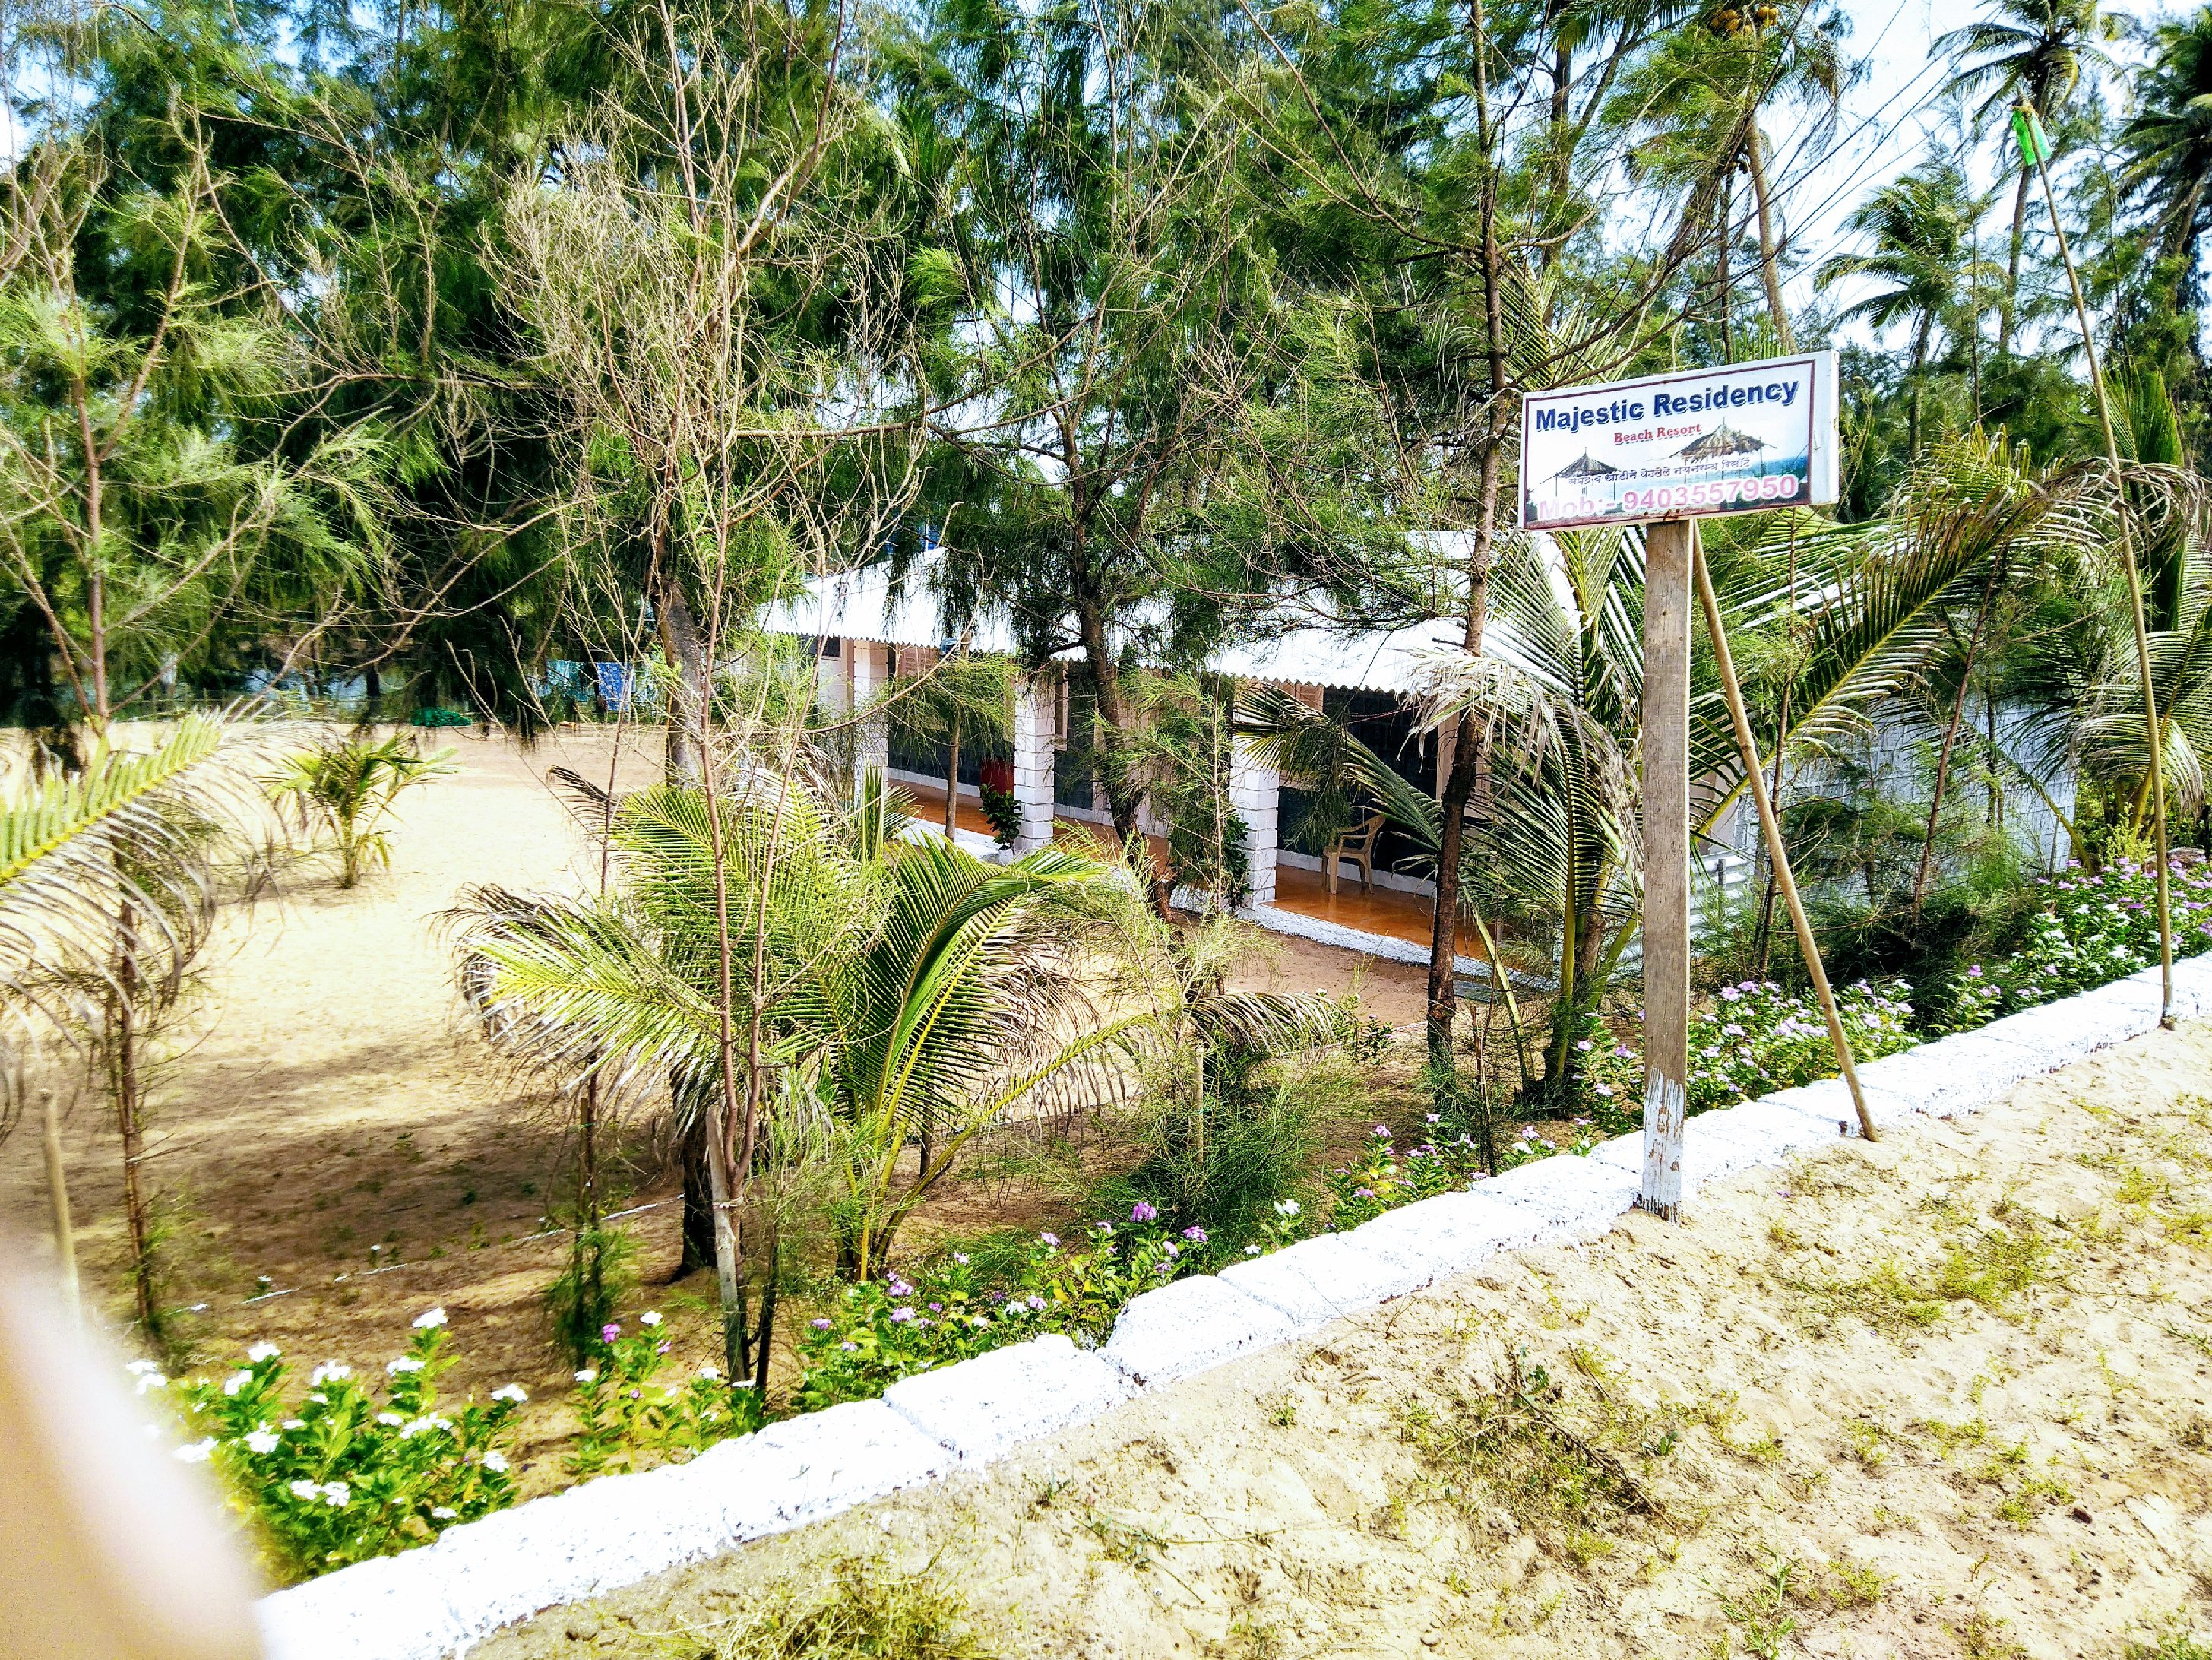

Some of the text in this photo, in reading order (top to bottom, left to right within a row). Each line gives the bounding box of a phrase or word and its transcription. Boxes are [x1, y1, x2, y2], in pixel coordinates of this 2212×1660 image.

[1536, 381, 1800, 433] Majestic Residency
[1613, 423, 1702, 445] Beach Resort
[1623, 476, 1799, 511] 9403557950
